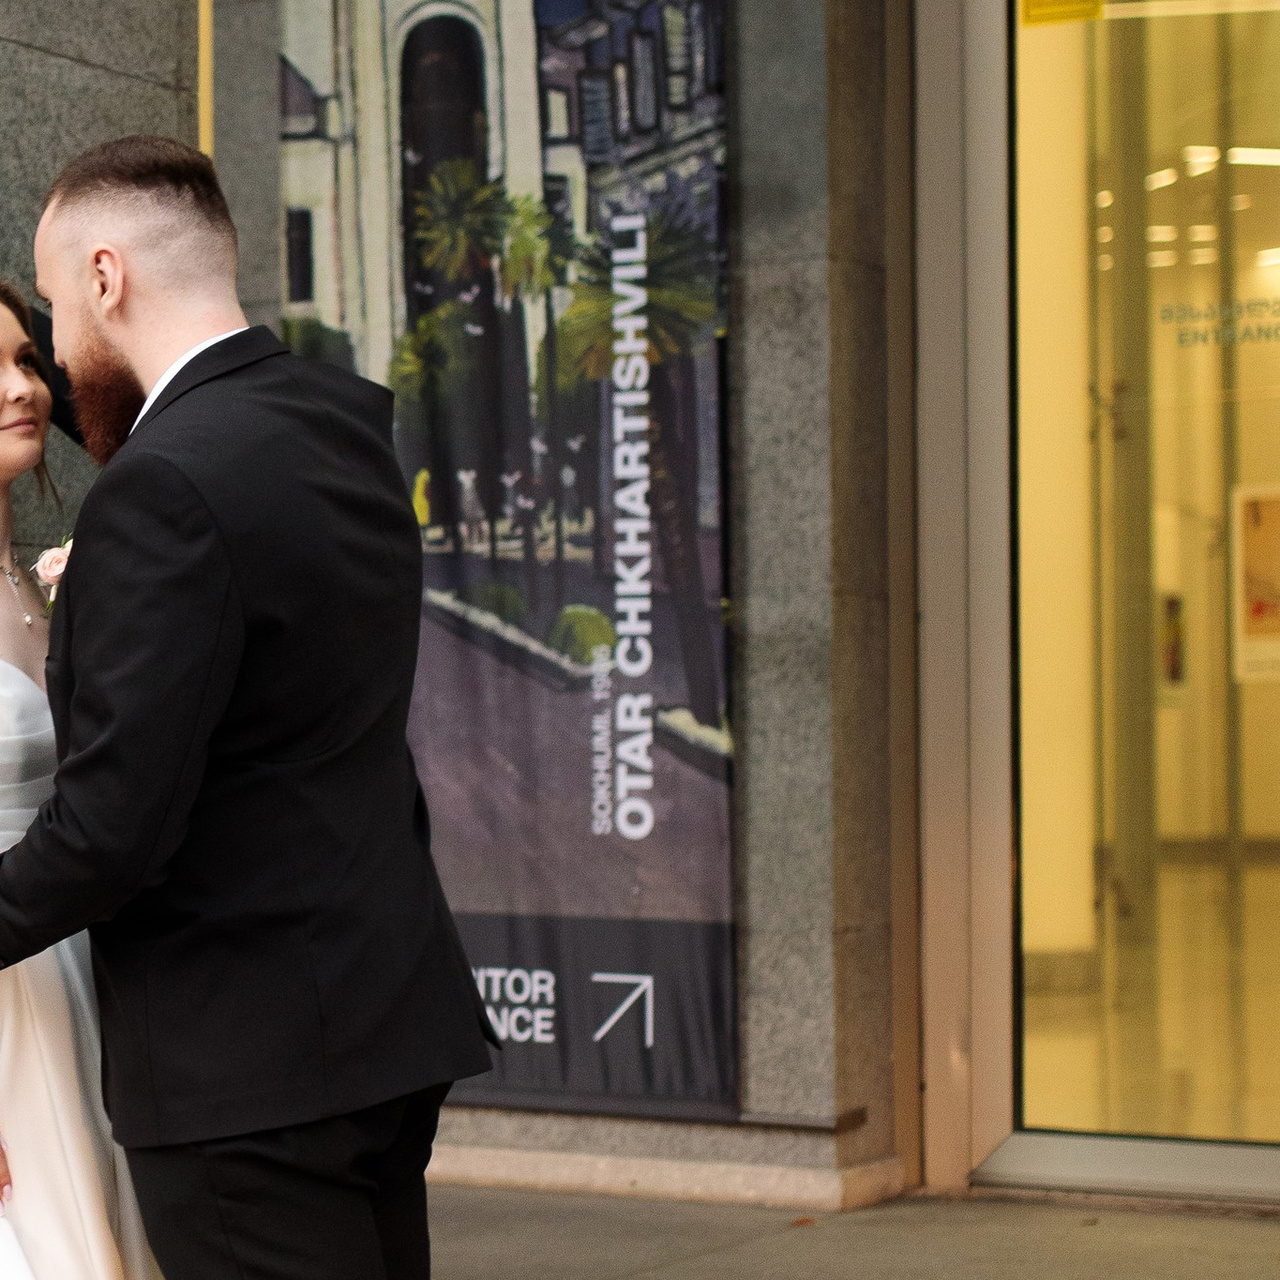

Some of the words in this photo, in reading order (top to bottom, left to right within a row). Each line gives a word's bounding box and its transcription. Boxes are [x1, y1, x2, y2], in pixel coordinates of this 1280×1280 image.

[611, 214, 653, 677] CHKHARTISHVILI
[616, 692, 654, 840] OTAR
[471, 967, 556, 1004] ITOR
